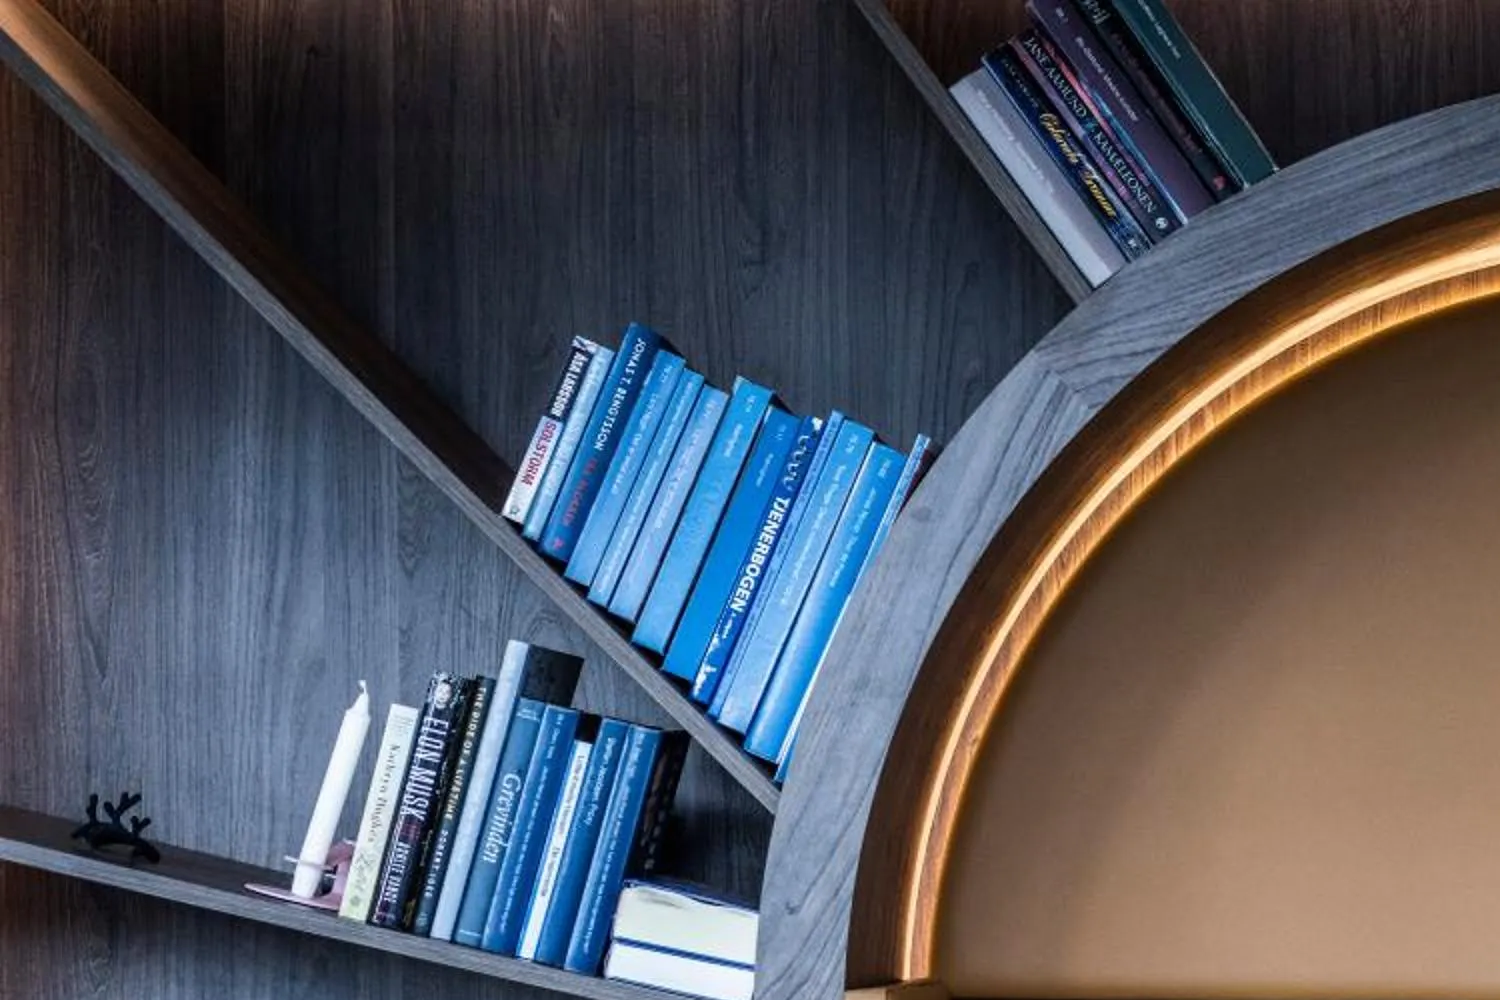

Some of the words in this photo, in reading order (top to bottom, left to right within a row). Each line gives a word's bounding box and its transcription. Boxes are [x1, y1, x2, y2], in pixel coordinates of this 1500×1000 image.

[625, 337, 647, 375] JONAS
[594, 387, 628, 451] BENGTSSON
[521, 421, 557, 486] SOLSTORM
[730, 496, 790, 616] TJENERBOGEN
[416, 717, 450, 762] ELON
[400, 757, 438, 821] MUSK
[482, 772, 522, 864] Grevinden
